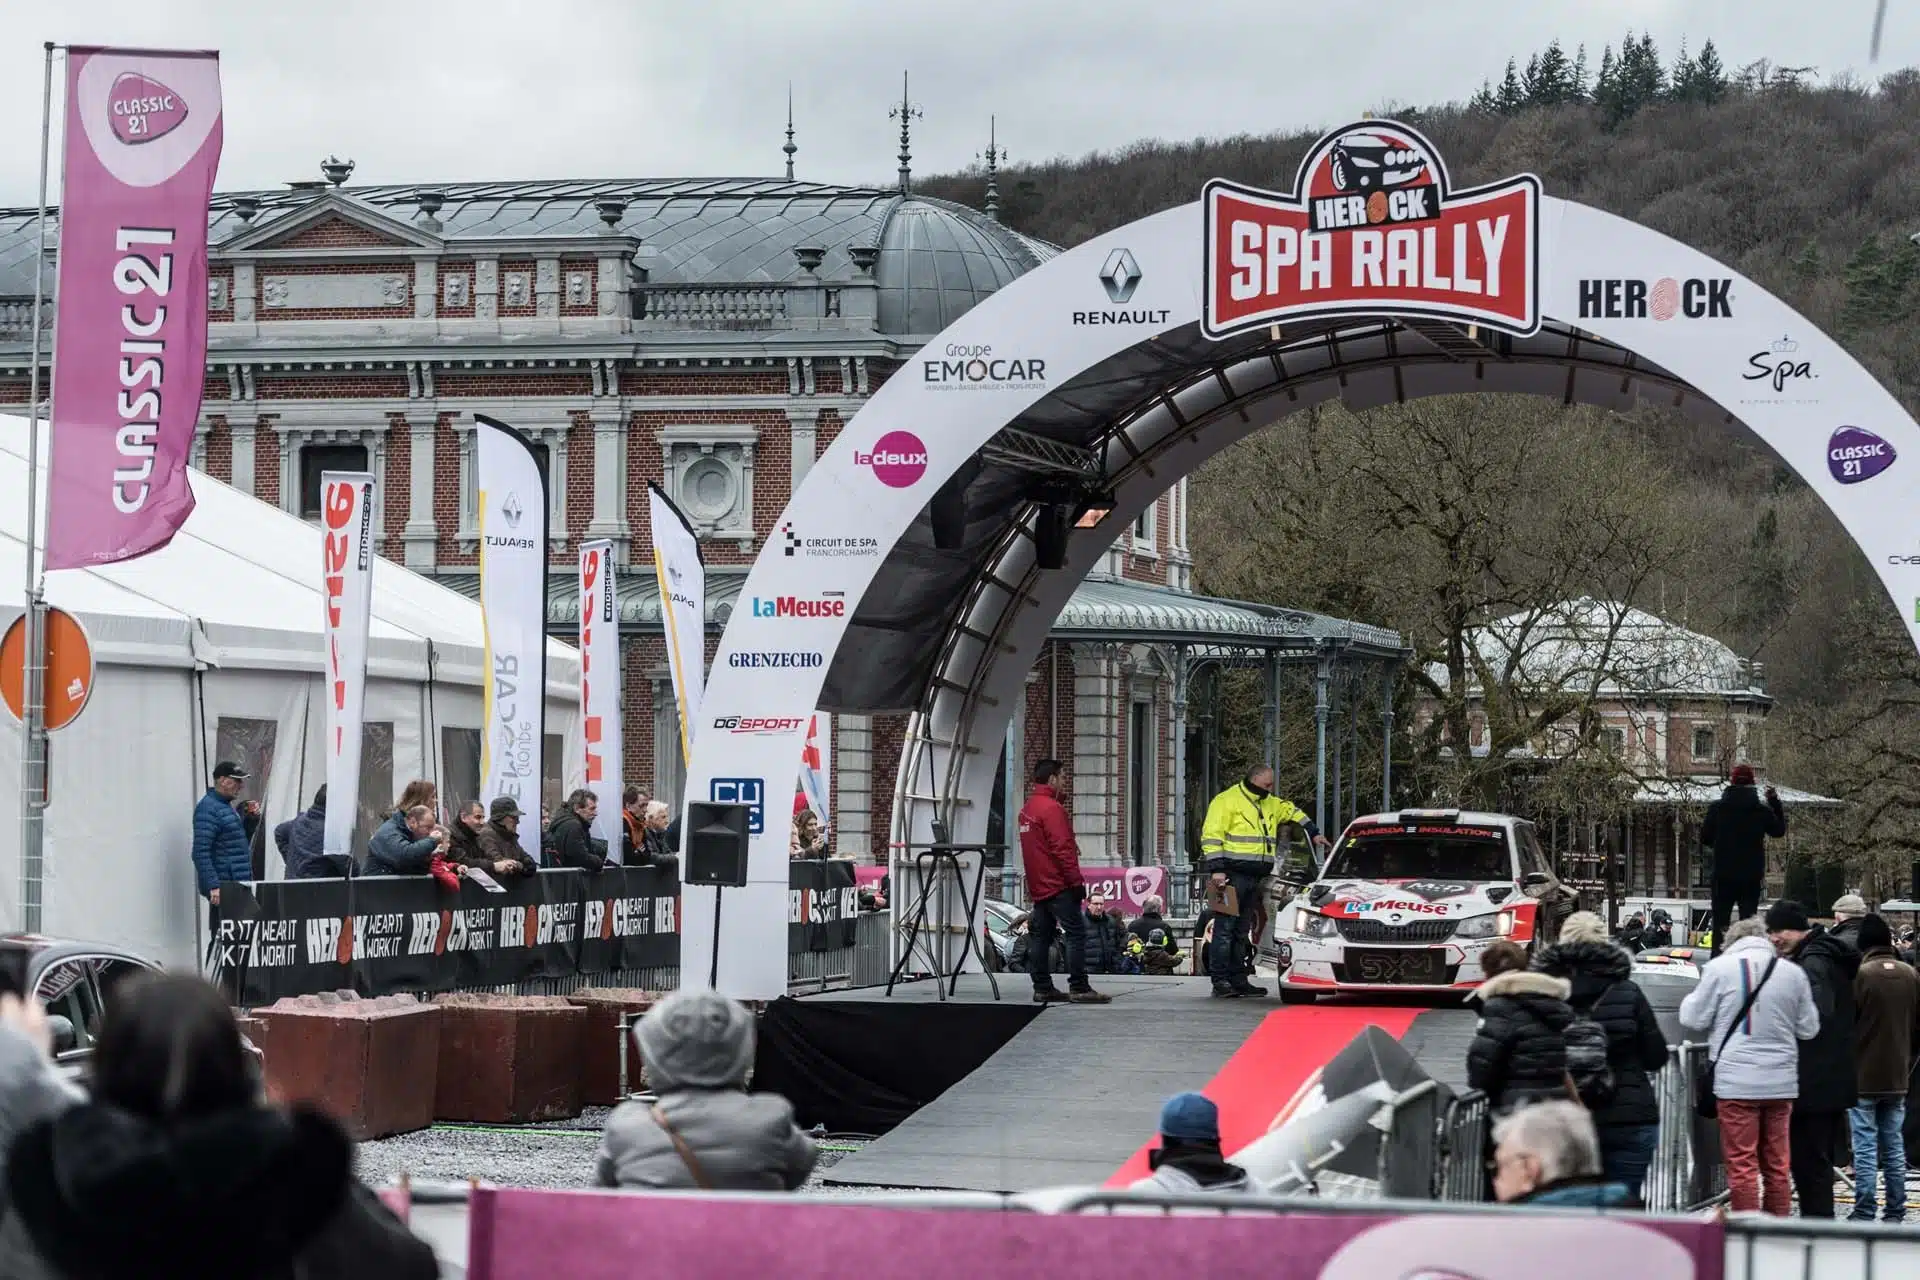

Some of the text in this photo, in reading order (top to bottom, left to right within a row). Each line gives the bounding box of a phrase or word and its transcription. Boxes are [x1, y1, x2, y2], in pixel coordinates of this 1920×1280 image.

[114, 95, 174, 115] CLASSIC
[129, 115, 148, 134] 21
[1315, 189, 1428, 230] HEROCK
[1230, 214, 1511, 301] SPA RALLY
[1578, 277, 1734, 321] HEROCK
[1073, 310, 1170, 325] RENAULT
[945, 343, 992, 360] Groupe
[923, 360, 1046, 382] EMOCAR
[1830, 443, 1886, 461] CLASSIC
[1843, 460, 1861, 476] 21
[806, 538, 878, 547] CIRCUIT DE SPA
[728, 651, 823, 668] GRENZECHO
[1418, 826, 1492, 837] INSULATION
[1102, 879, 1122, 900] 21
[486, 907, 494, 927] IT
[569, 902, 578, 920] IT
[261, 919, 298, 941] WEAR IT
[368, 913, 403, 934] WEAR IT
[568, 923, 576, 942] IT
[366, 936, 402, 958] WORK IT
[486, 930, 494, 949] IT
[261, 944, 297, 967] WORK IT
